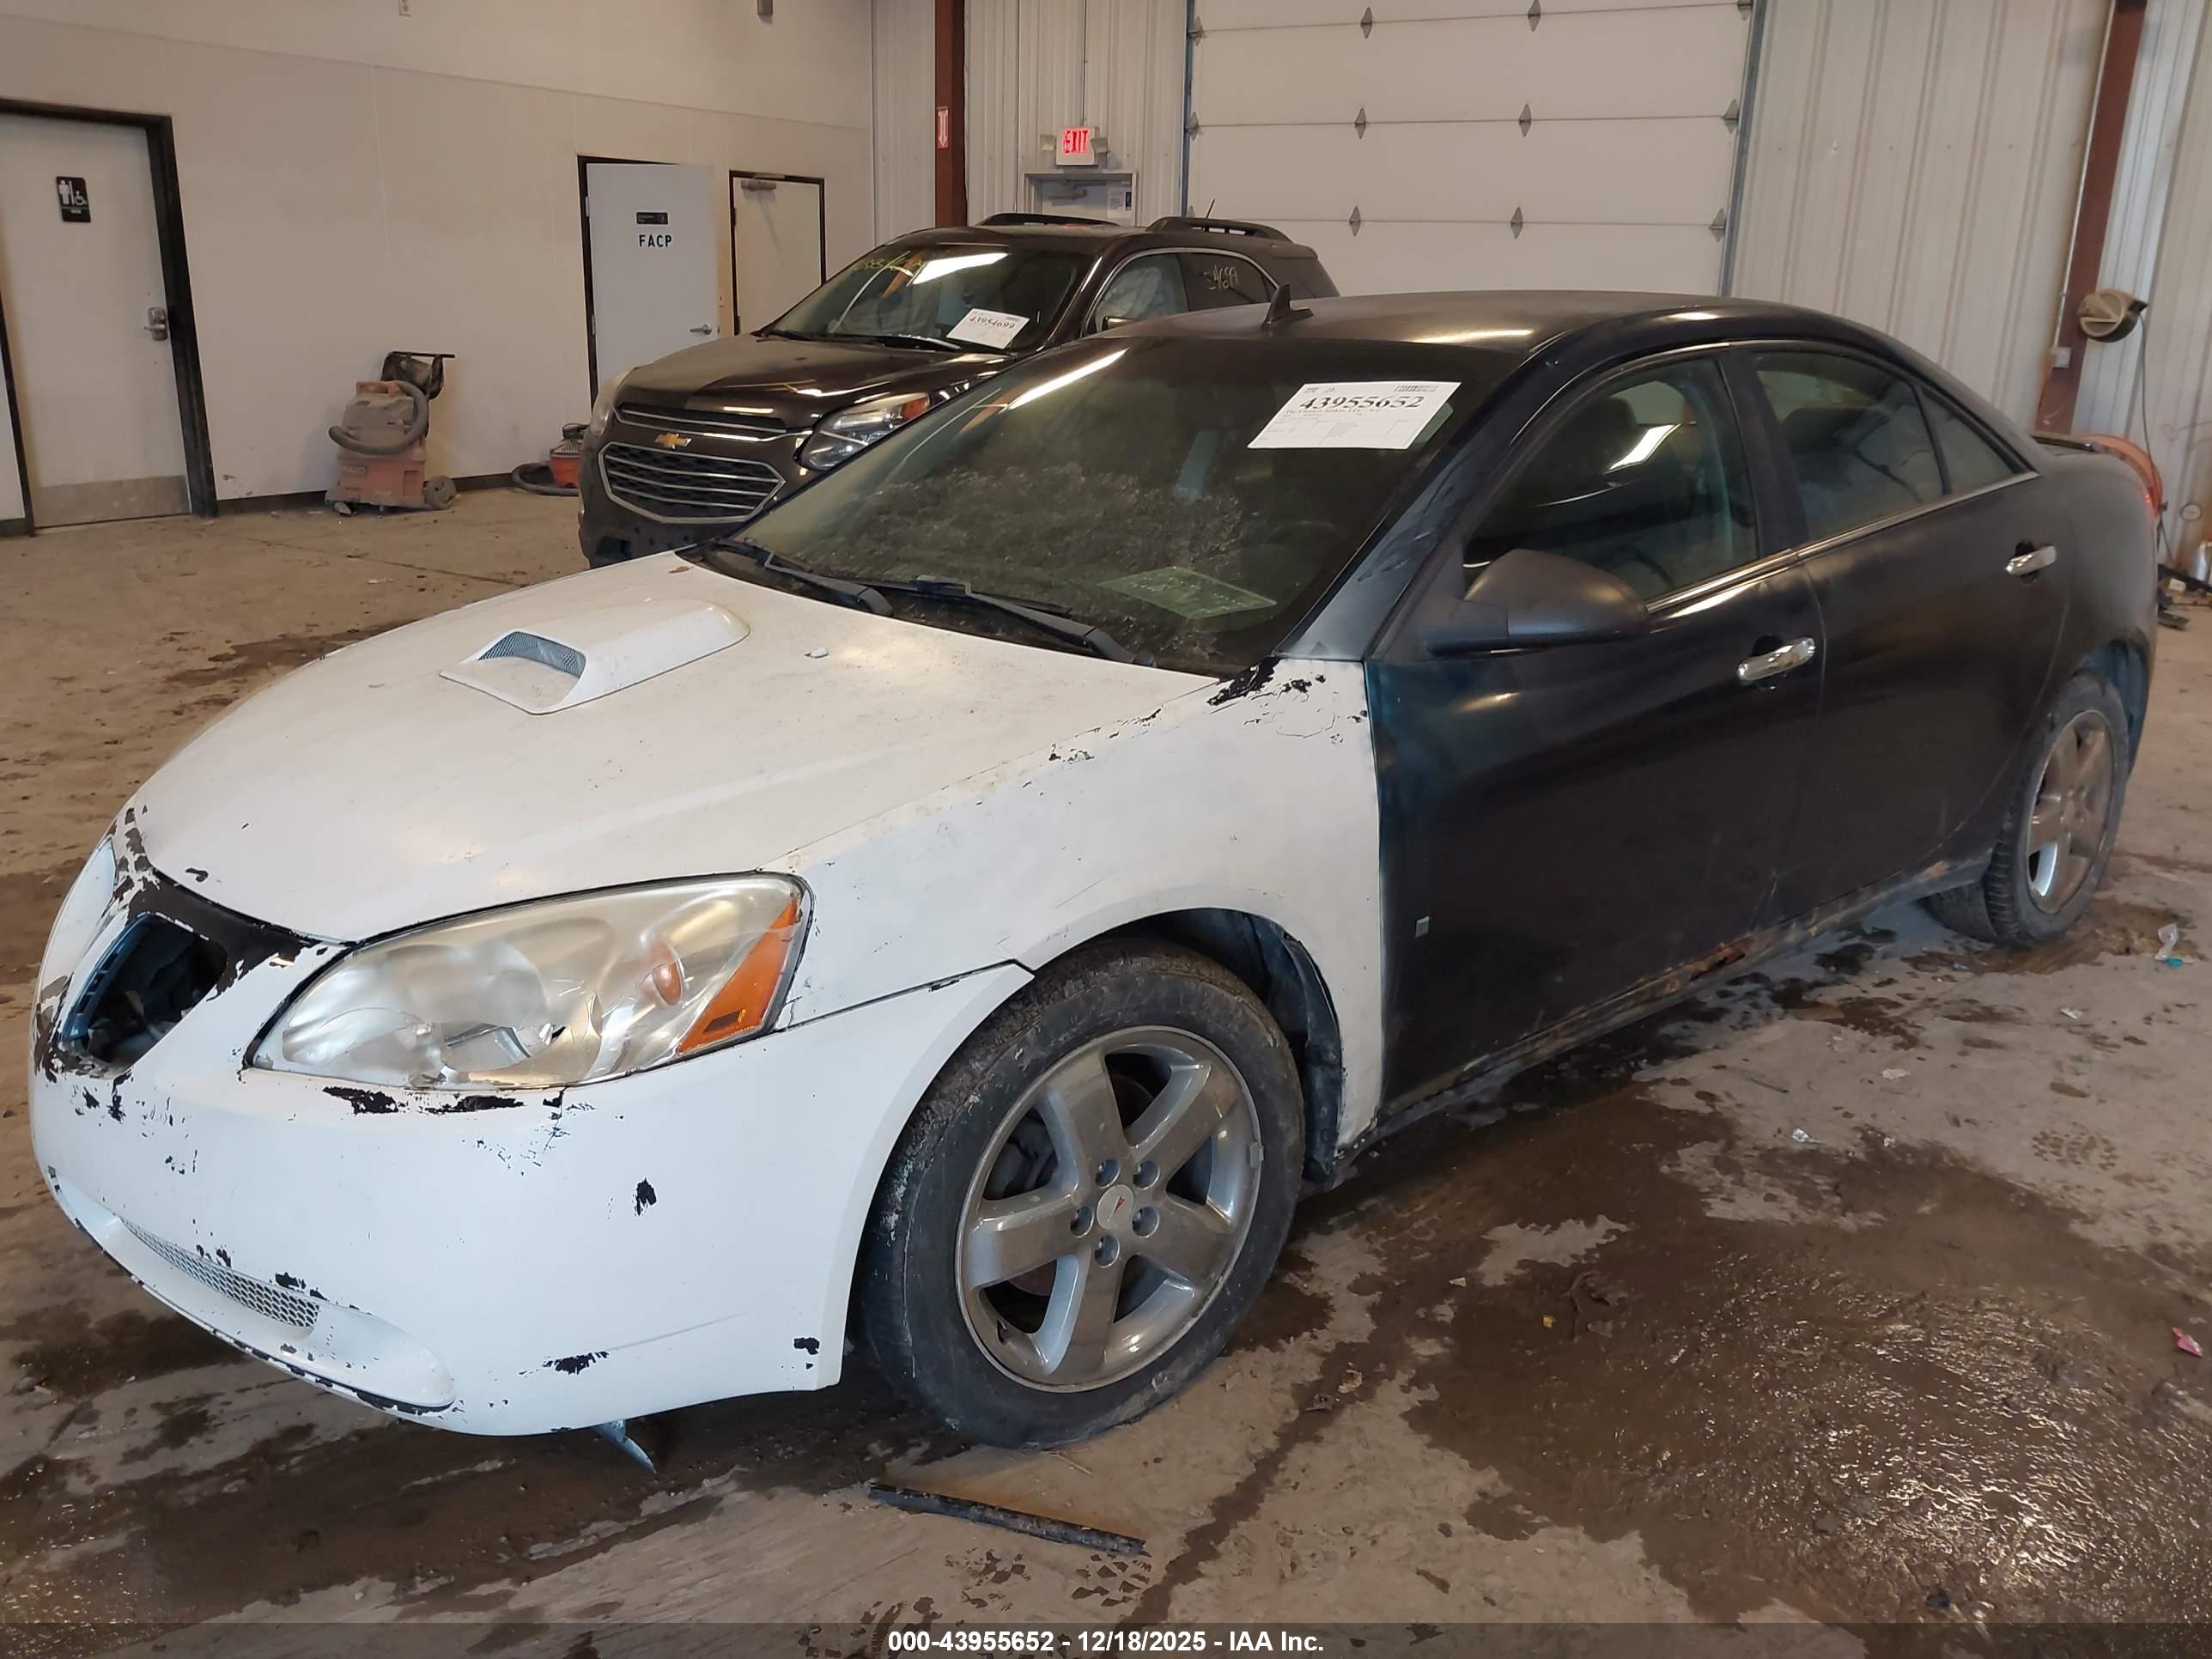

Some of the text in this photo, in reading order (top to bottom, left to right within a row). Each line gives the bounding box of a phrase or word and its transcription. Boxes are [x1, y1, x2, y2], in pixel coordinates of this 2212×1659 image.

[1063, 130, 1089, 153] EXIT
[639, 234, 672, 247] FACP
[1299, 395, 1425, 410] 43955652
